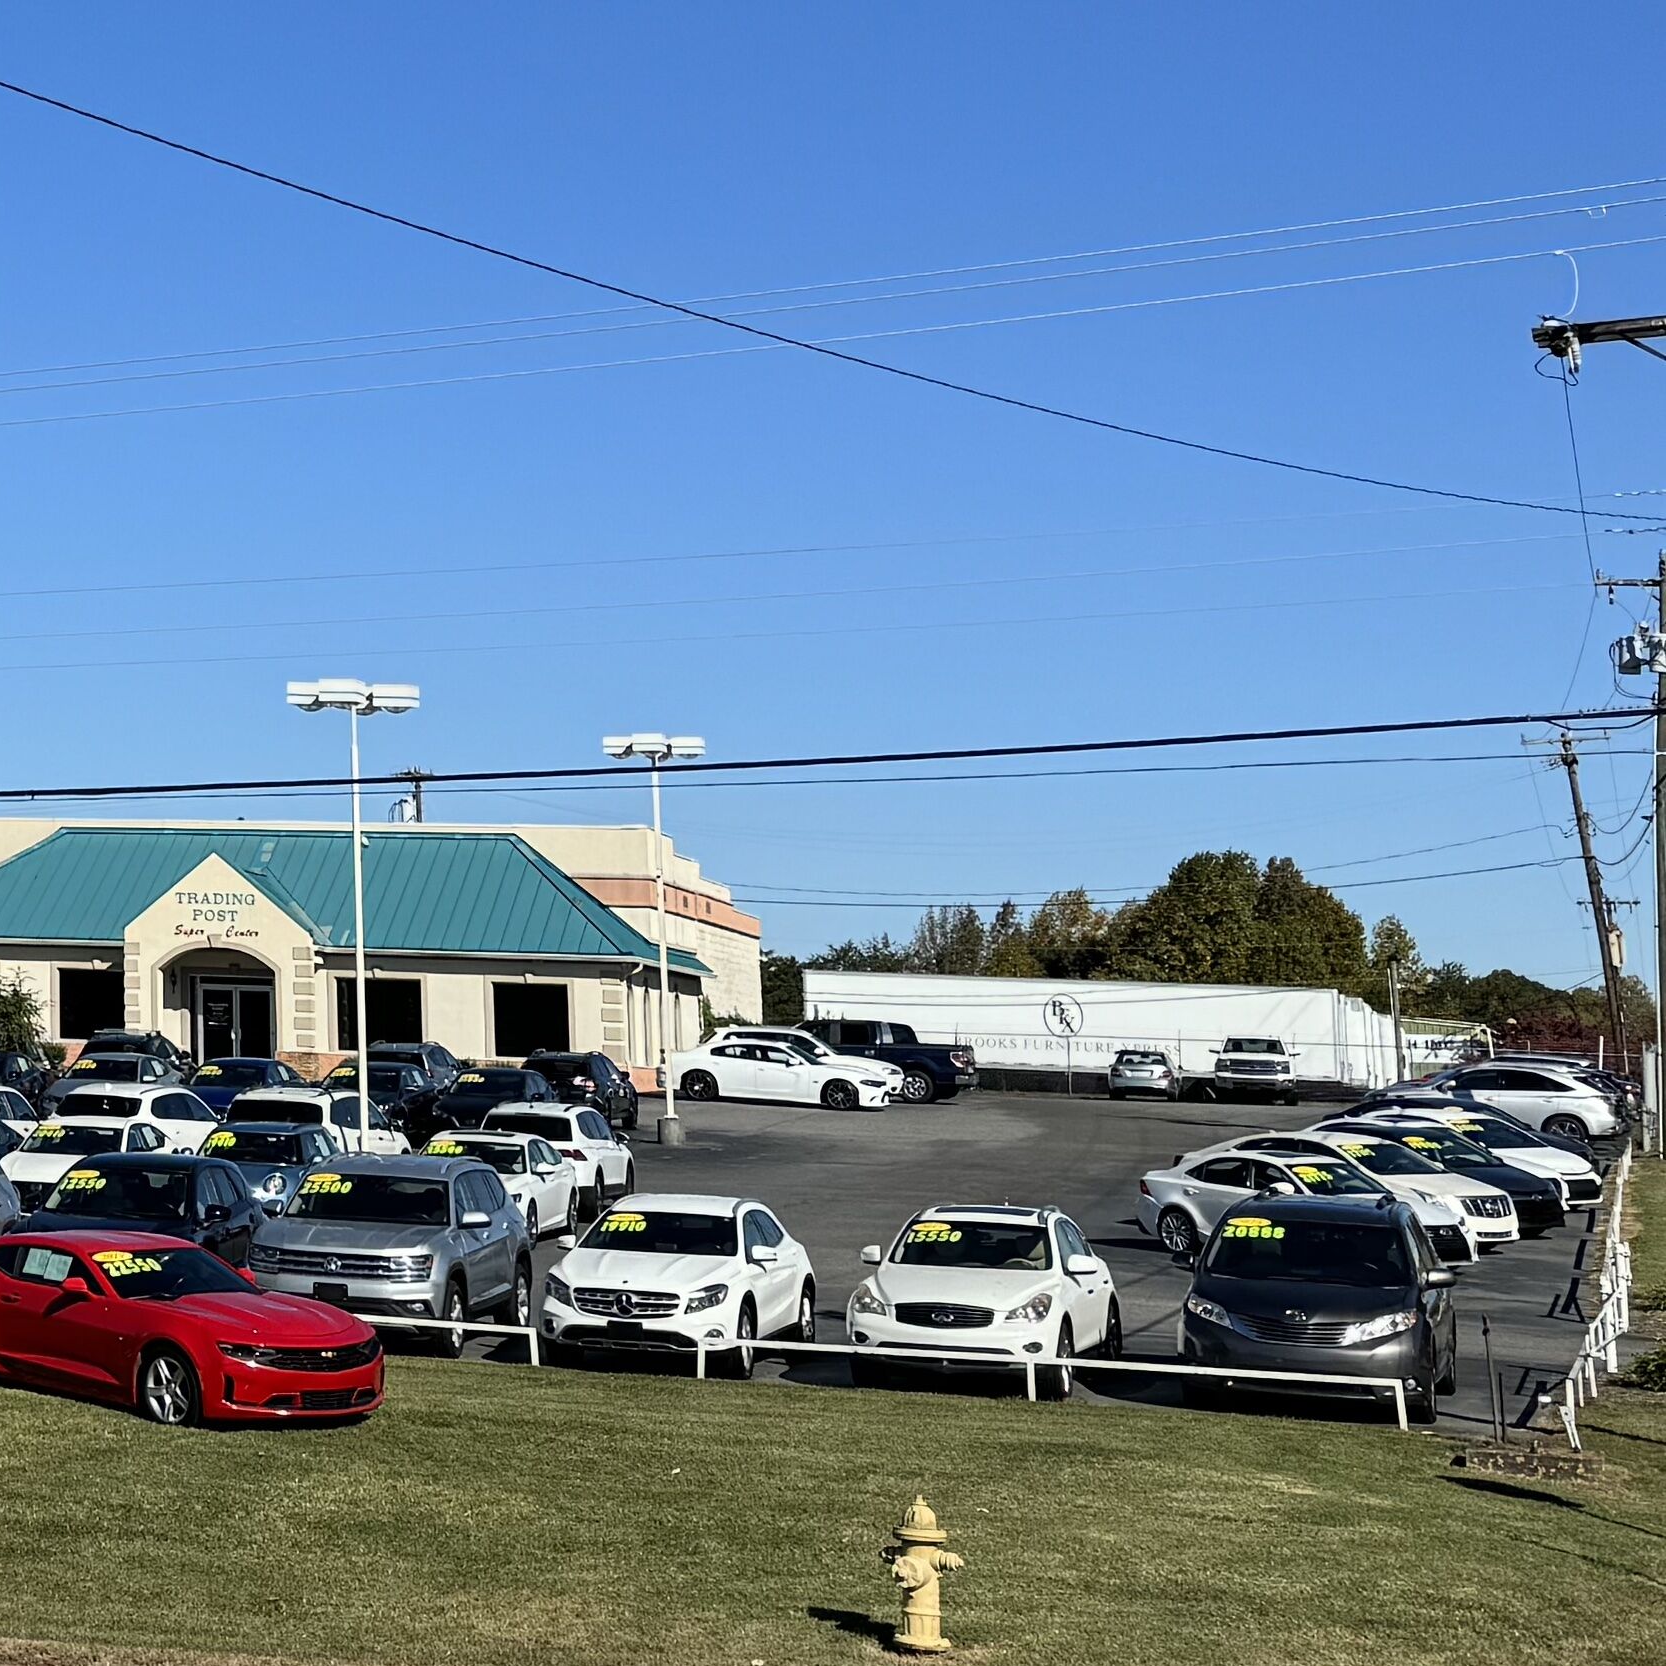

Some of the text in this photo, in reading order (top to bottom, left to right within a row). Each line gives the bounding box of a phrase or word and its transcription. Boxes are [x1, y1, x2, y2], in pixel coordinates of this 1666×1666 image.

[175, 892, 255, 906] TRADING
[193, 909, 238, 922] POST
[1023, 1038, 1115, 1053] FURNTURE
[298, 1181, 353, 1195] 25500
[600, 1221, 646, 1231] 19910
[907, 1230, 962, 1243] 15550
[102, 1258, 162, 1277] 22550
